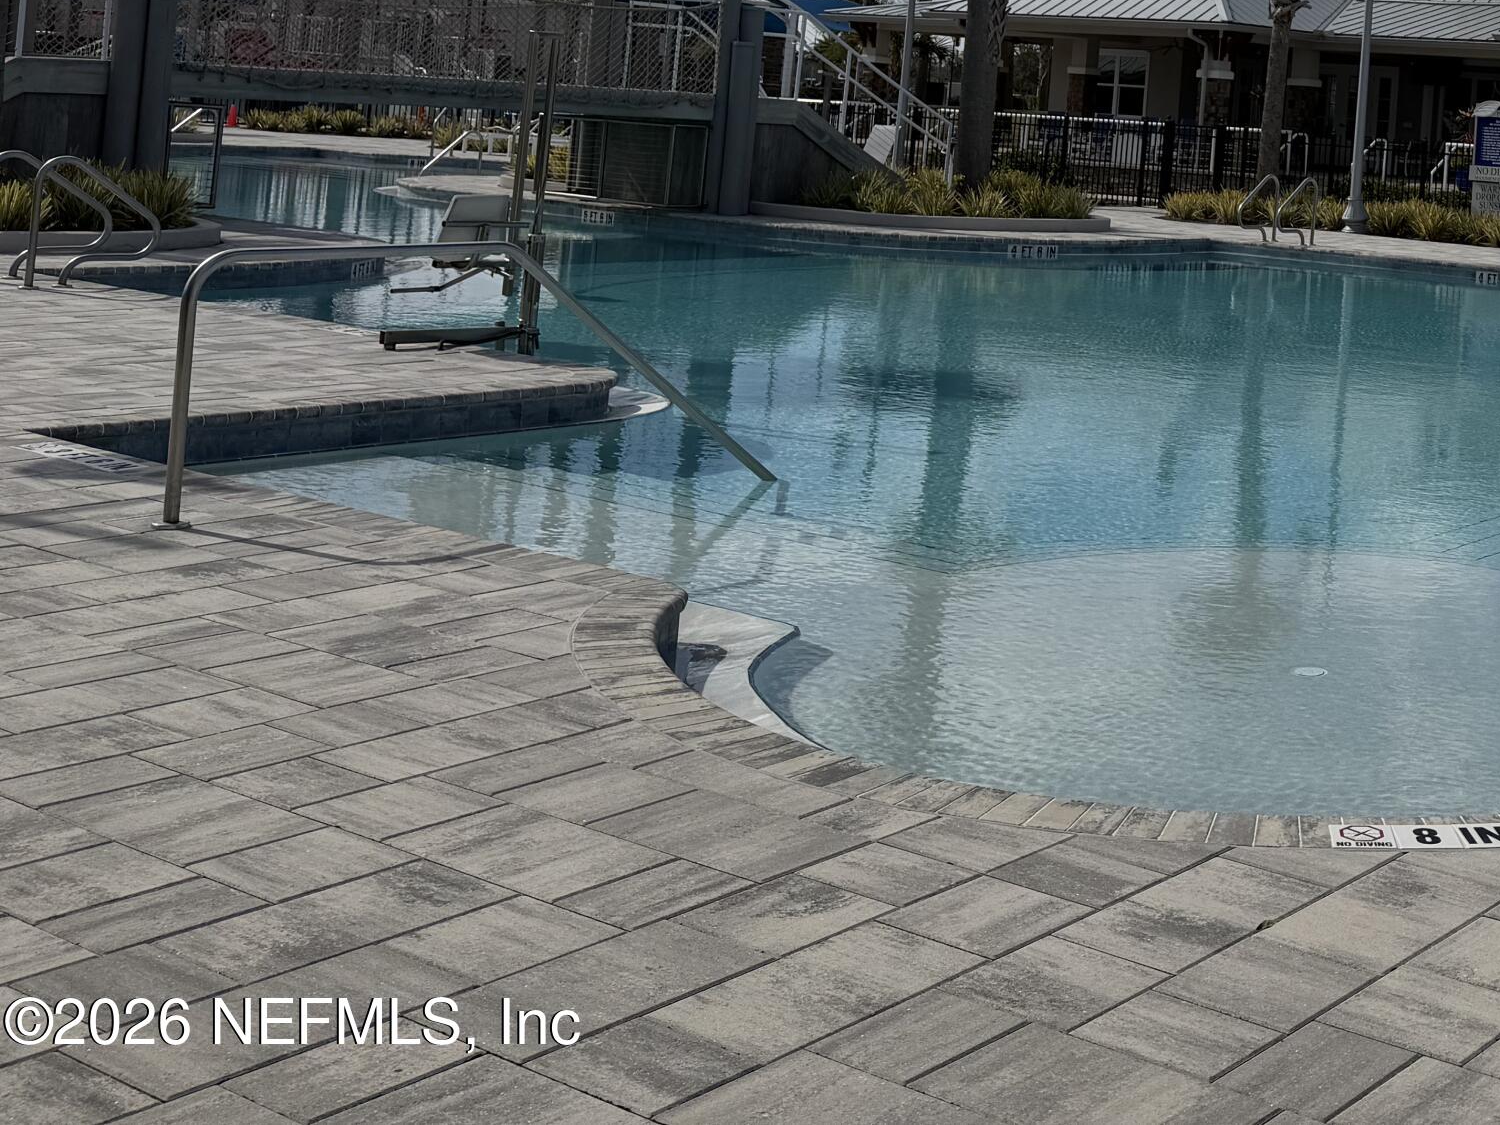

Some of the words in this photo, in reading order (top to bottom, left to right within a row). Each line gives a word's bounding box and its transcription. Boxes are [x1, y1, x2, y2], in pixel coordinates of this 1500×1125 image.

[1476, 167, 1489, 175] NO
[1475, 192, 1496, 201] DROP
[1011, 245, 1018, 258] 4
[1046, 246, 1057, 259] IN
[1412, 827, 1442, 845] 8
